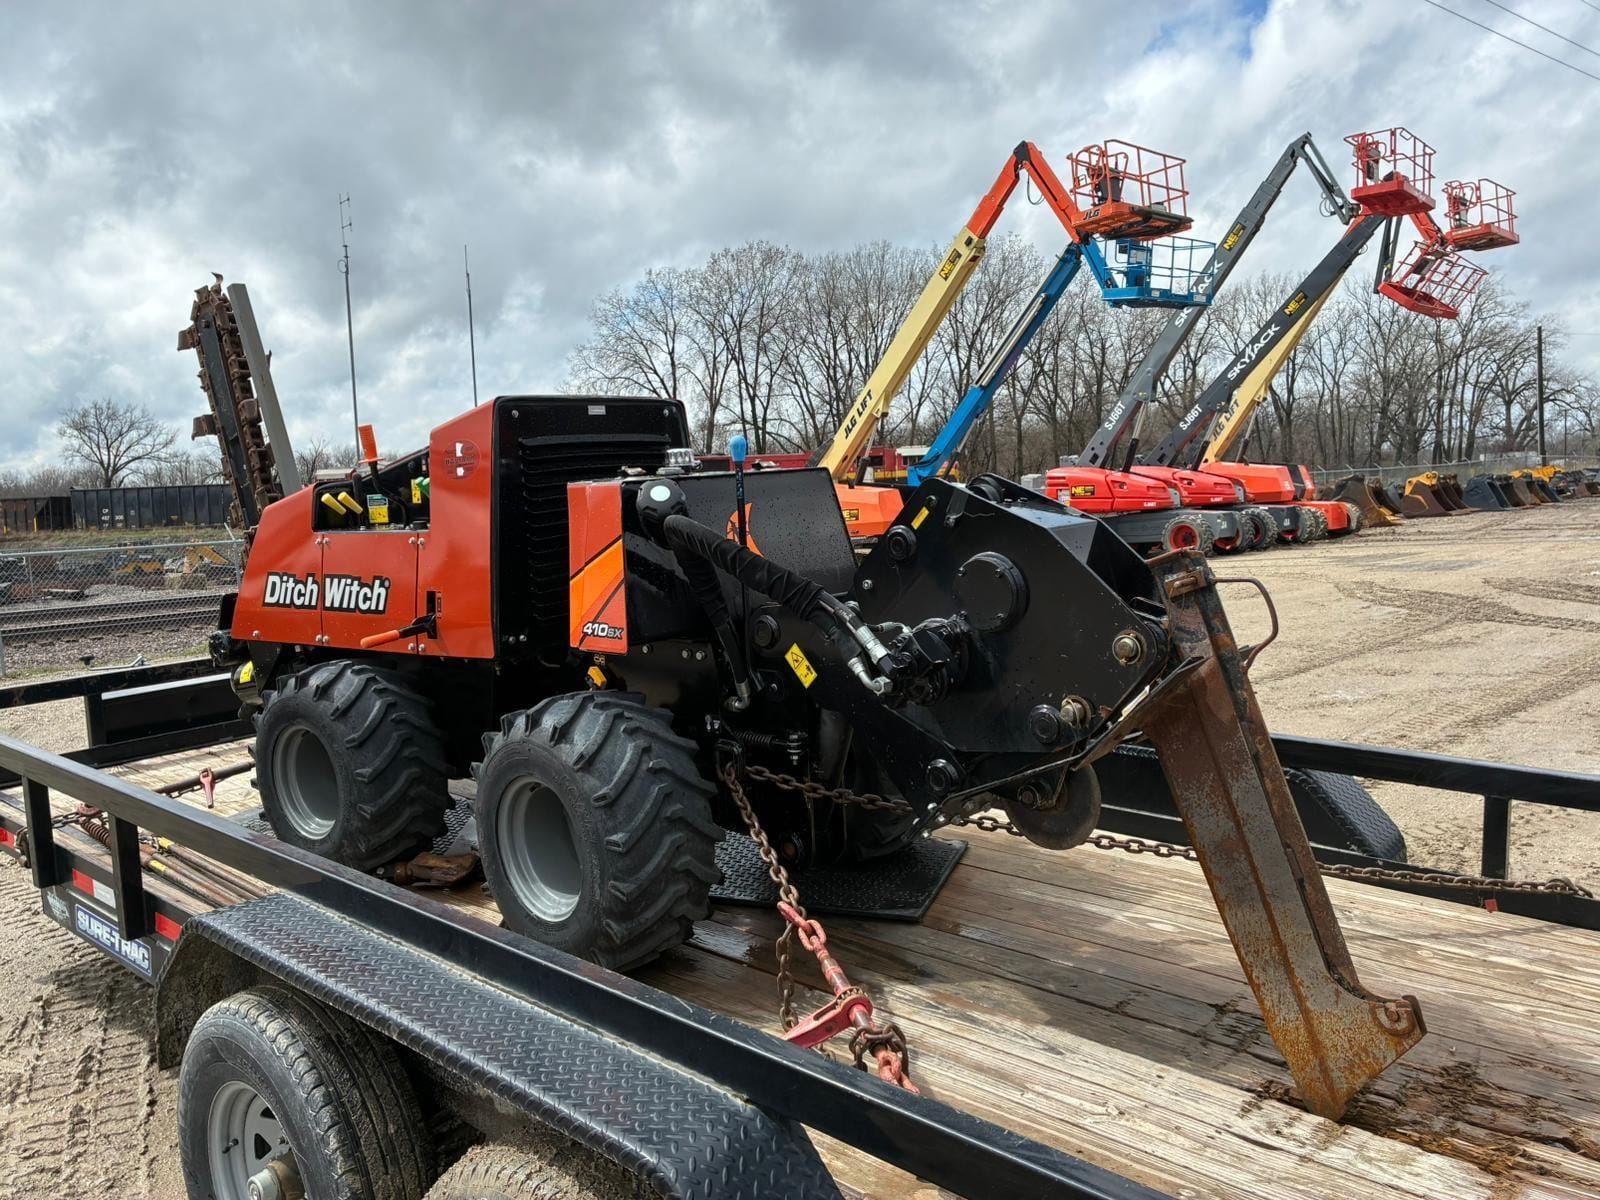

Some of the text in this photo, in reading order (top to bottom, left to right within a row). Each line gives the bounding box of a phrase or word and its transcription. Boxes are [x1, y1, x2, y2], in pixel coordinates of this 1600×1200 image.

[1083, 209, 1101, 221] JLG
[1174, 259, 1224, 328] SKACK
[1227, 323, 1281, 381] SKYJACK
[844, 389, 872, 440] JLG LIFT
[1104, 400, 1126, 431] SJ66T
[1179, 403, 1203, 431] SJ66T
[263, 574, 387, 611] Ditch Witch
[582, 622, 623, 639] 410SX
[77, 910, 149, 969] SURE-TRAC
